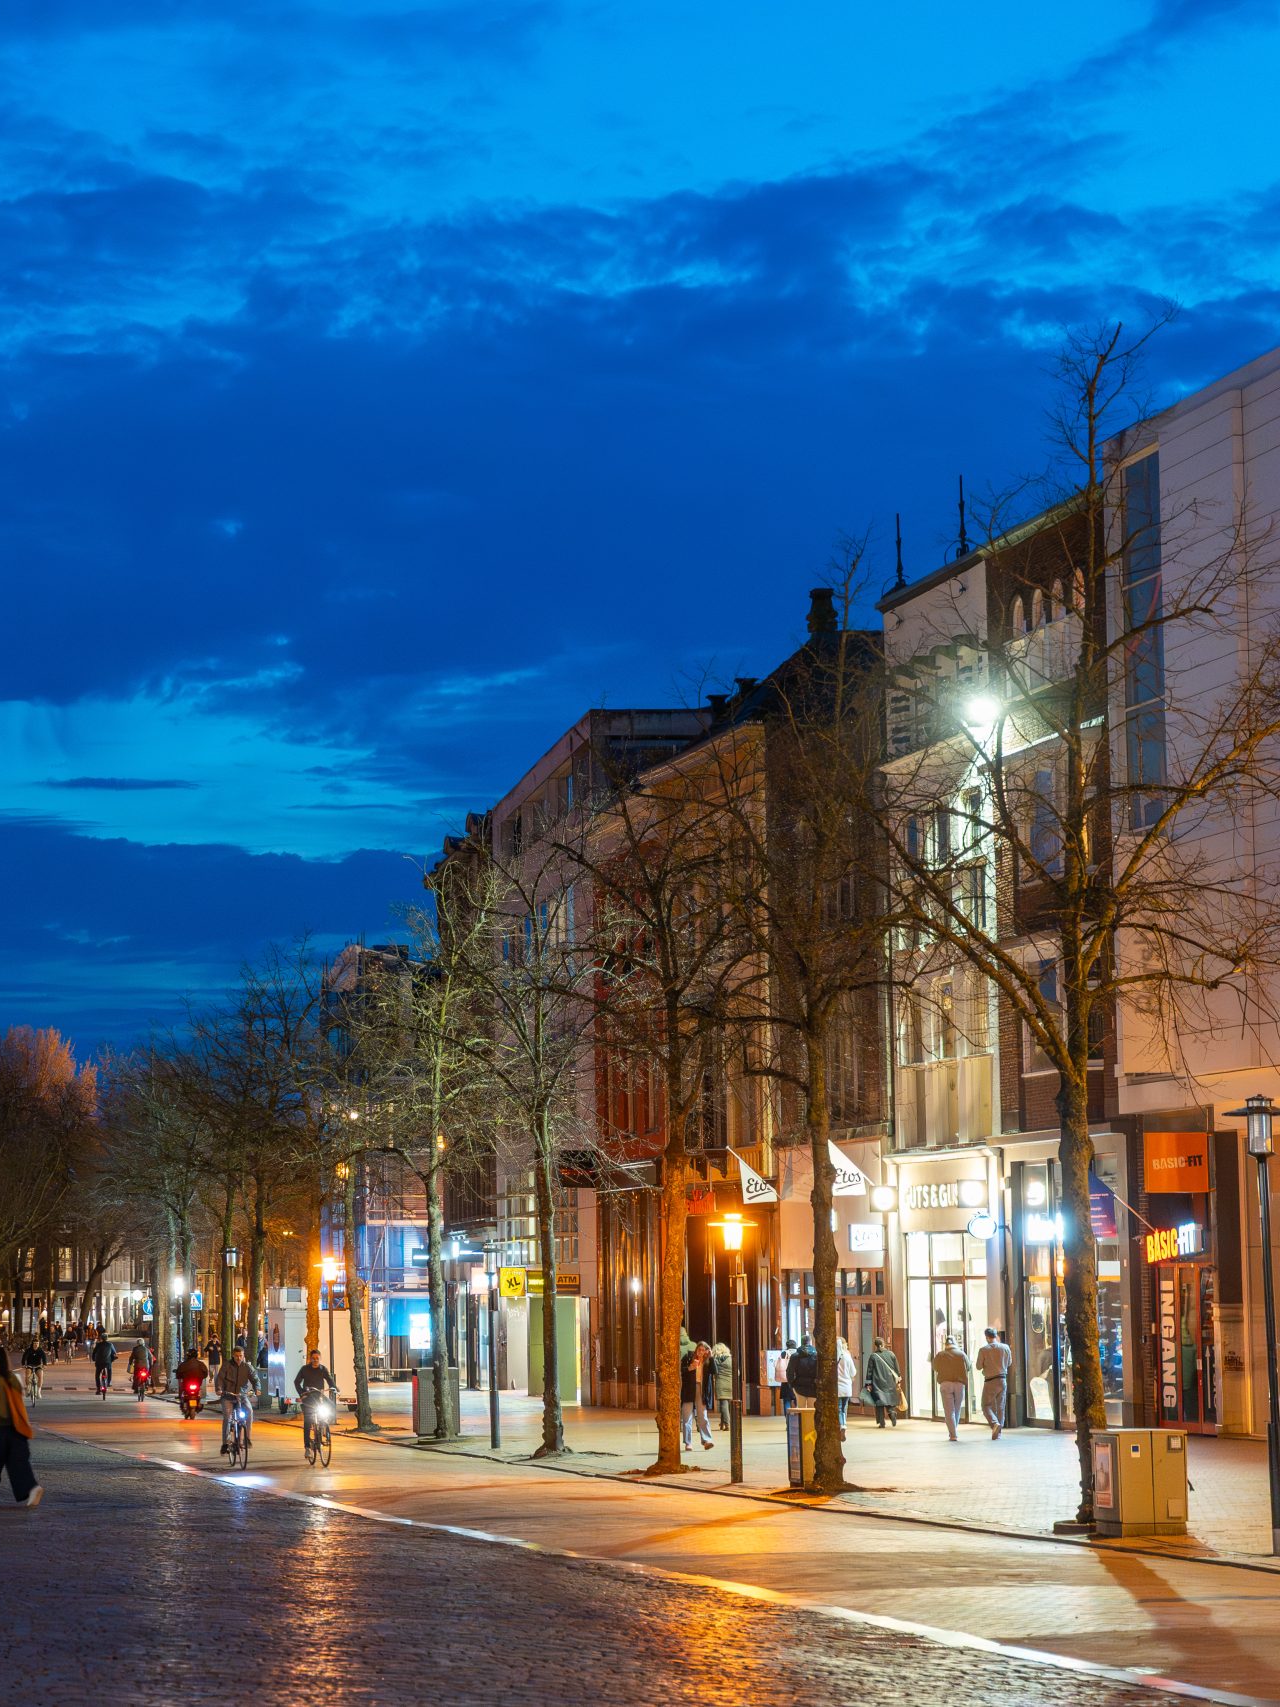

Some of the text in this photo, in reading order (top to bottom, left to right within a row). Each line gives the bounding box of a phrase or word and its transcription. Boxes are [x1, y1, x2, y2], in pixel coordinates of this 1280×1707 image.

[1152, 1154, 1204, 1171] BASIC-FIT
[1146, 1222, 1198, 1263] BASIC-FIT
[506, 1276, 521, 1289] XL
[557, 1276, 577, 1284] ATM
[1160, 1280, 1177, 1408] INGANG
